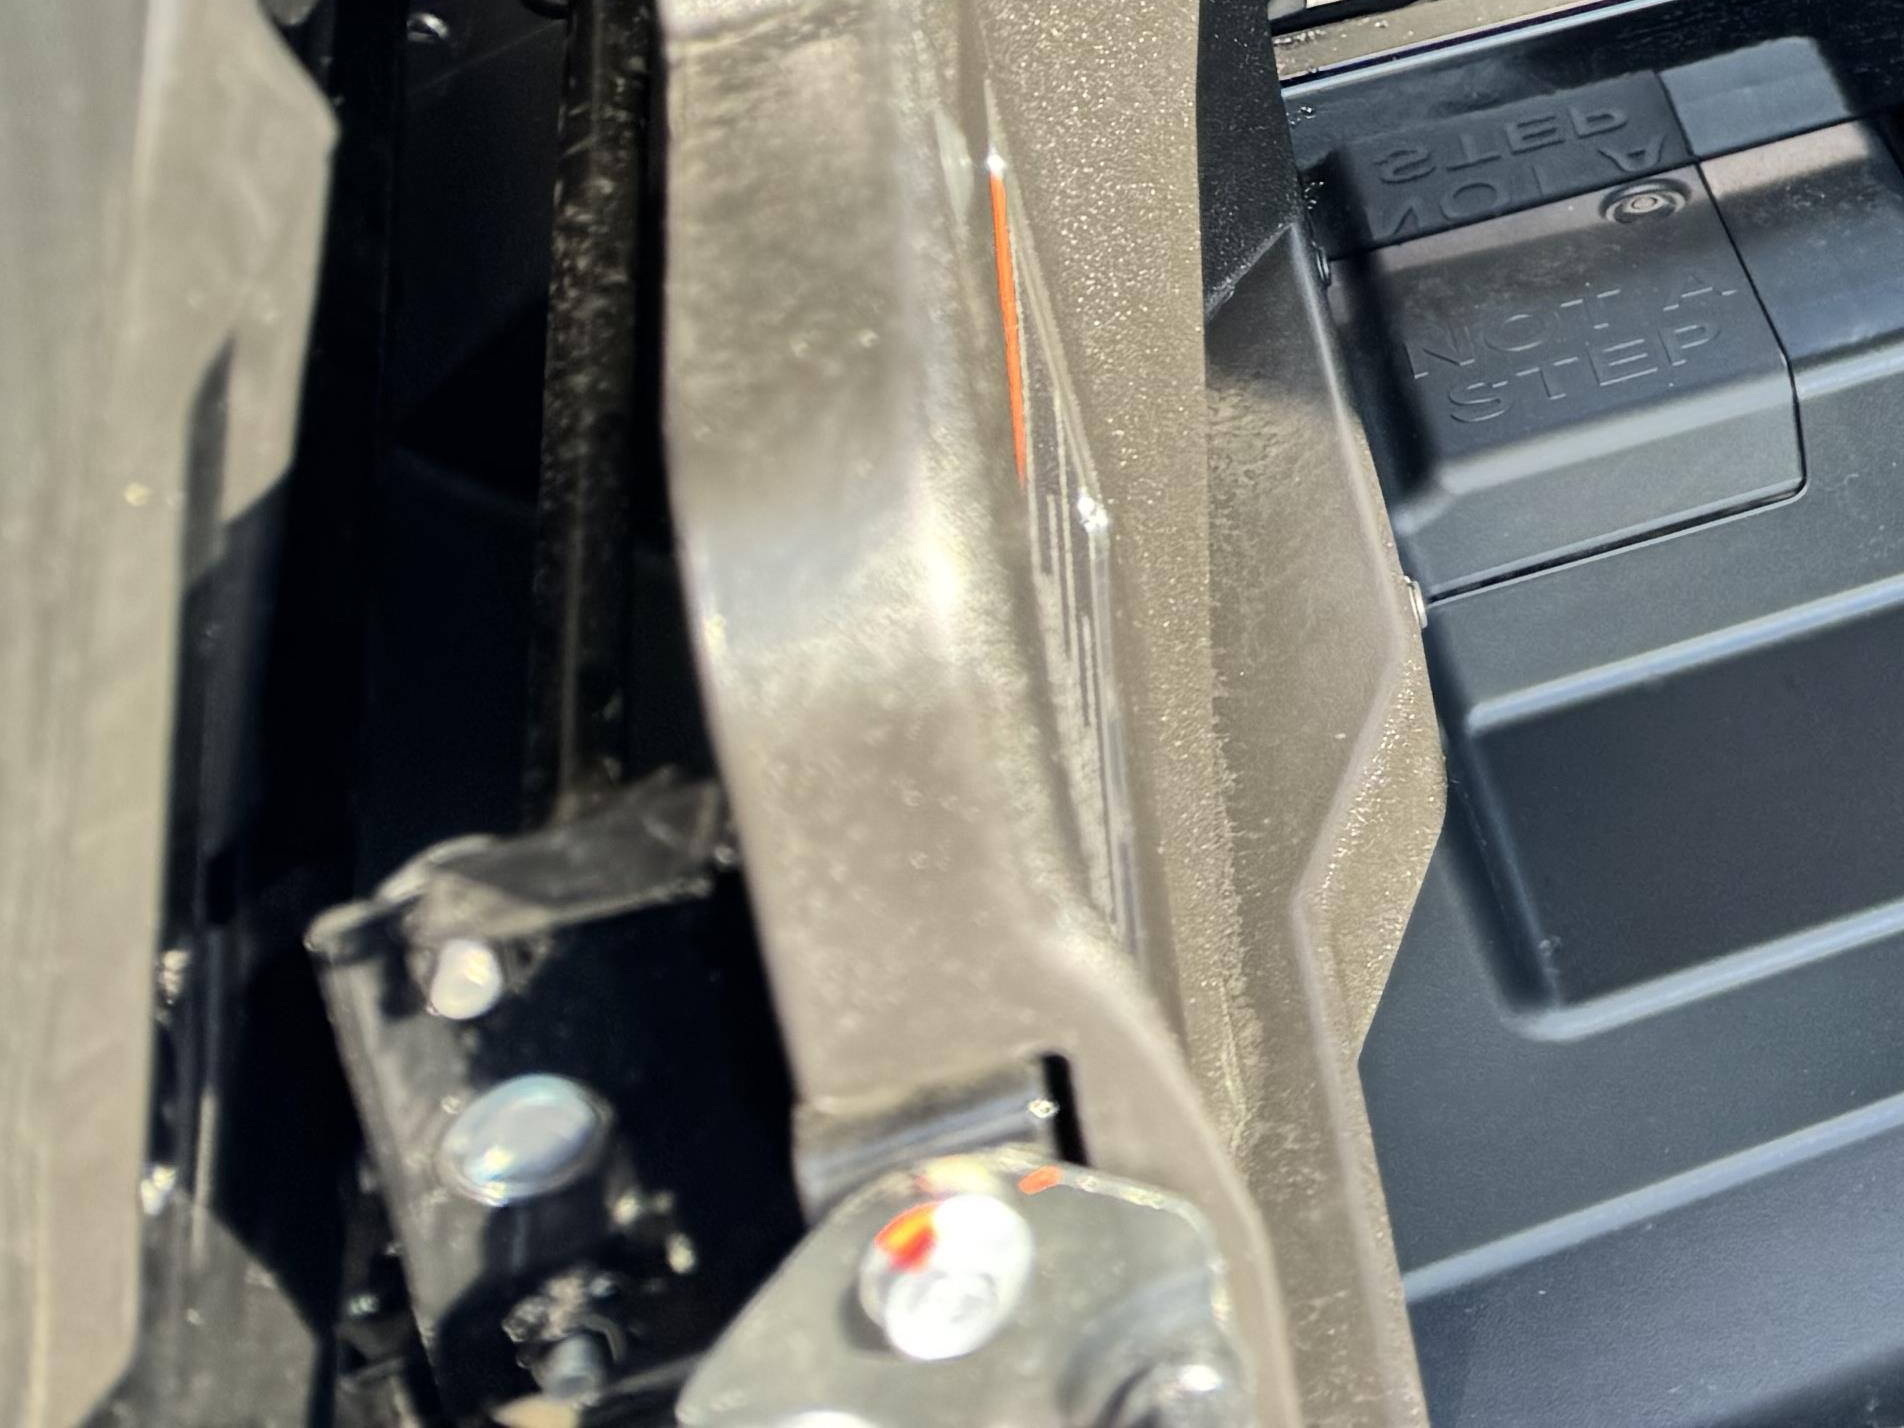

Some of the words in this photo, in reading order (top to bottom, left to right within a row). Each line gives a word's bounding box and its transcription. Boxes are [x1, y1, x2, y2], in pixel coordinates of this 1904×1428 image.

[1402, 287, 1621, 380] NOT
[1661, 272, 1738, 312] A
[1447, 322, 1722, 425] STEP
